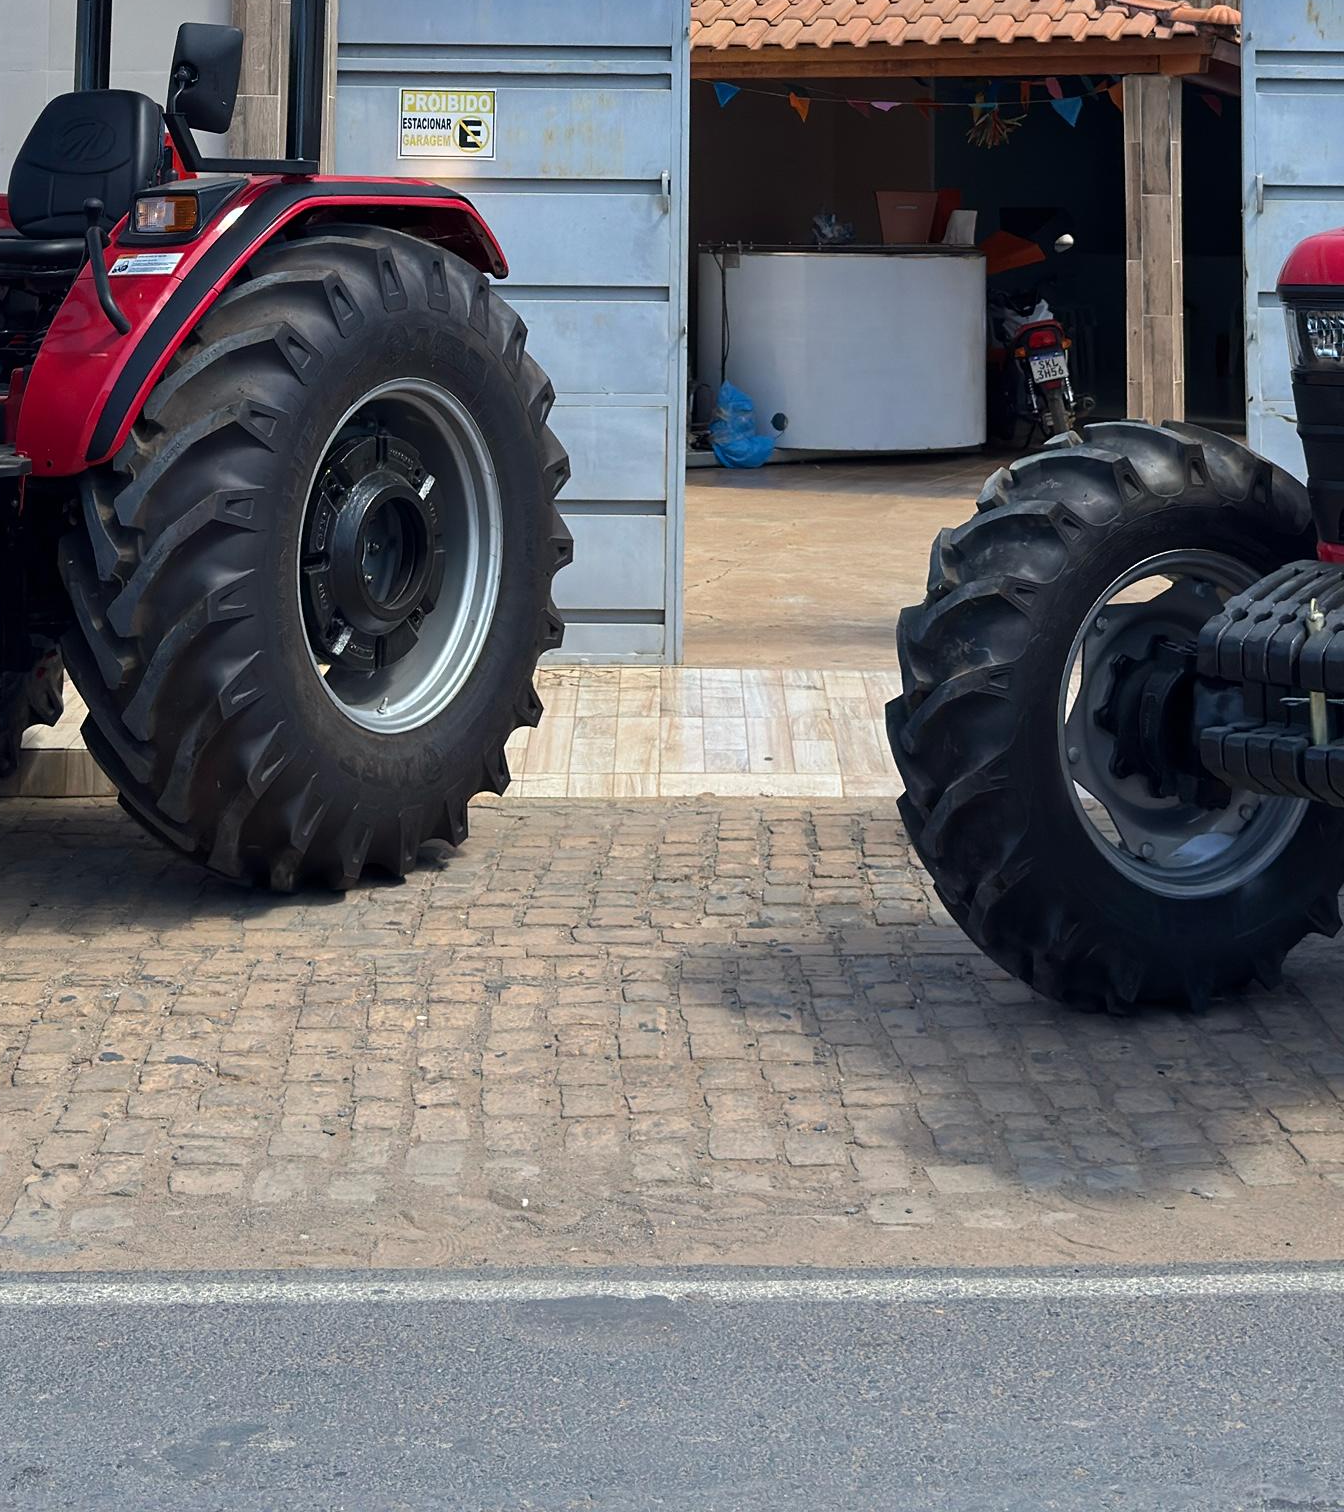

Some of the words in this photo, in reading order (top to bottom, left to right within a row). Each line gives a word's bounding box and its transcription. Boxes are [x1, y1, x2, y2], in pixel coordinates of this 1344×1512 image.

[404, 93, 492, 112] PROIBIDO
[402, 117, 452, 130] ESTACIONAR
[403, 134, 451, 147] GARAGEM
[1038, 358, 1059, 369] SKL
